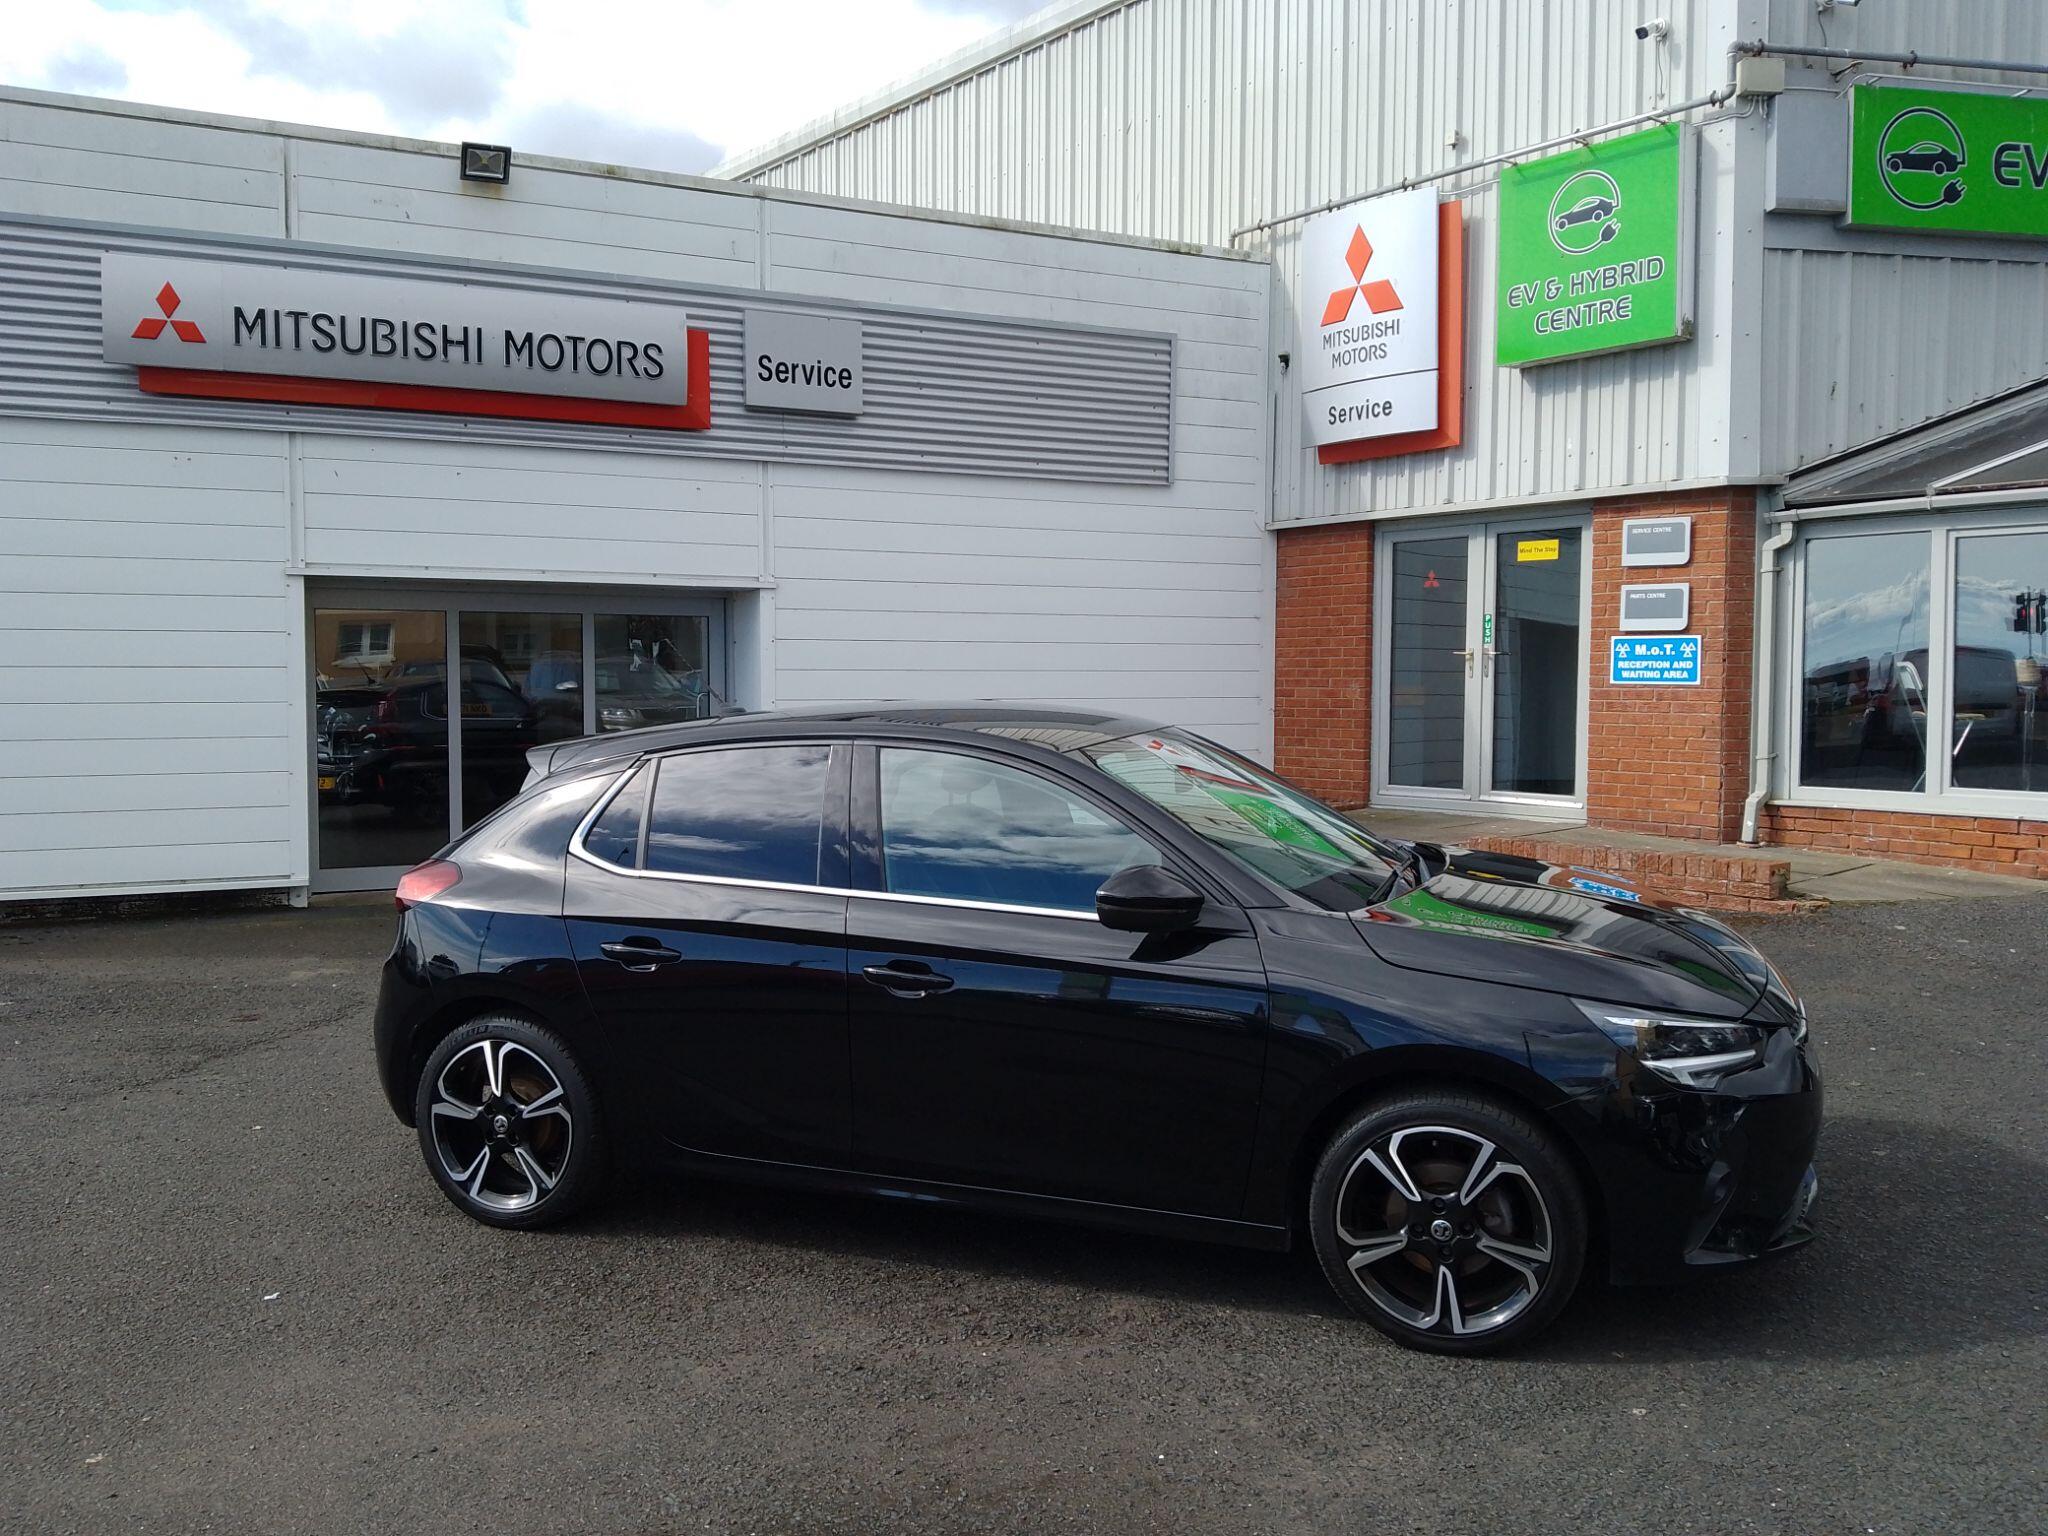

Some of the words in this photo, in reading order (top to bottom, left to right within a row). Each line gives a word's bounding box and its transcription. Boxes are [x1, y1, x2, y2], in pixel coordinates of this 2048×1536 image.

[1507, 281, 1540, 308] EV
[1545, 277, 1563, 301] &
[1569, 255, 1665, 297] HYBRID
[1534, 294, 1632, 335] CENTRE
[232, 305, 483, 365] MITSUBISHI
[503, 329, 665, 381] MOTORS
[1322, 318, 1401, 351] MITSUBISHI
[1331, 342, 1388, 369] MOTORS
[757, 353, 854, 390] Service
[1327, 398, 1393, 426] Service
[1647, 591, 1666, 599] CENTRE
[1635, 643, 1676, 656] M.o.T.
[1617, 660, 1670, 669] RECEPTION
[1672, 660, 1694, 669] AND
[1621, 670, 1660, 679] WAITING
[1663, 670, 1689, 679] AREA
